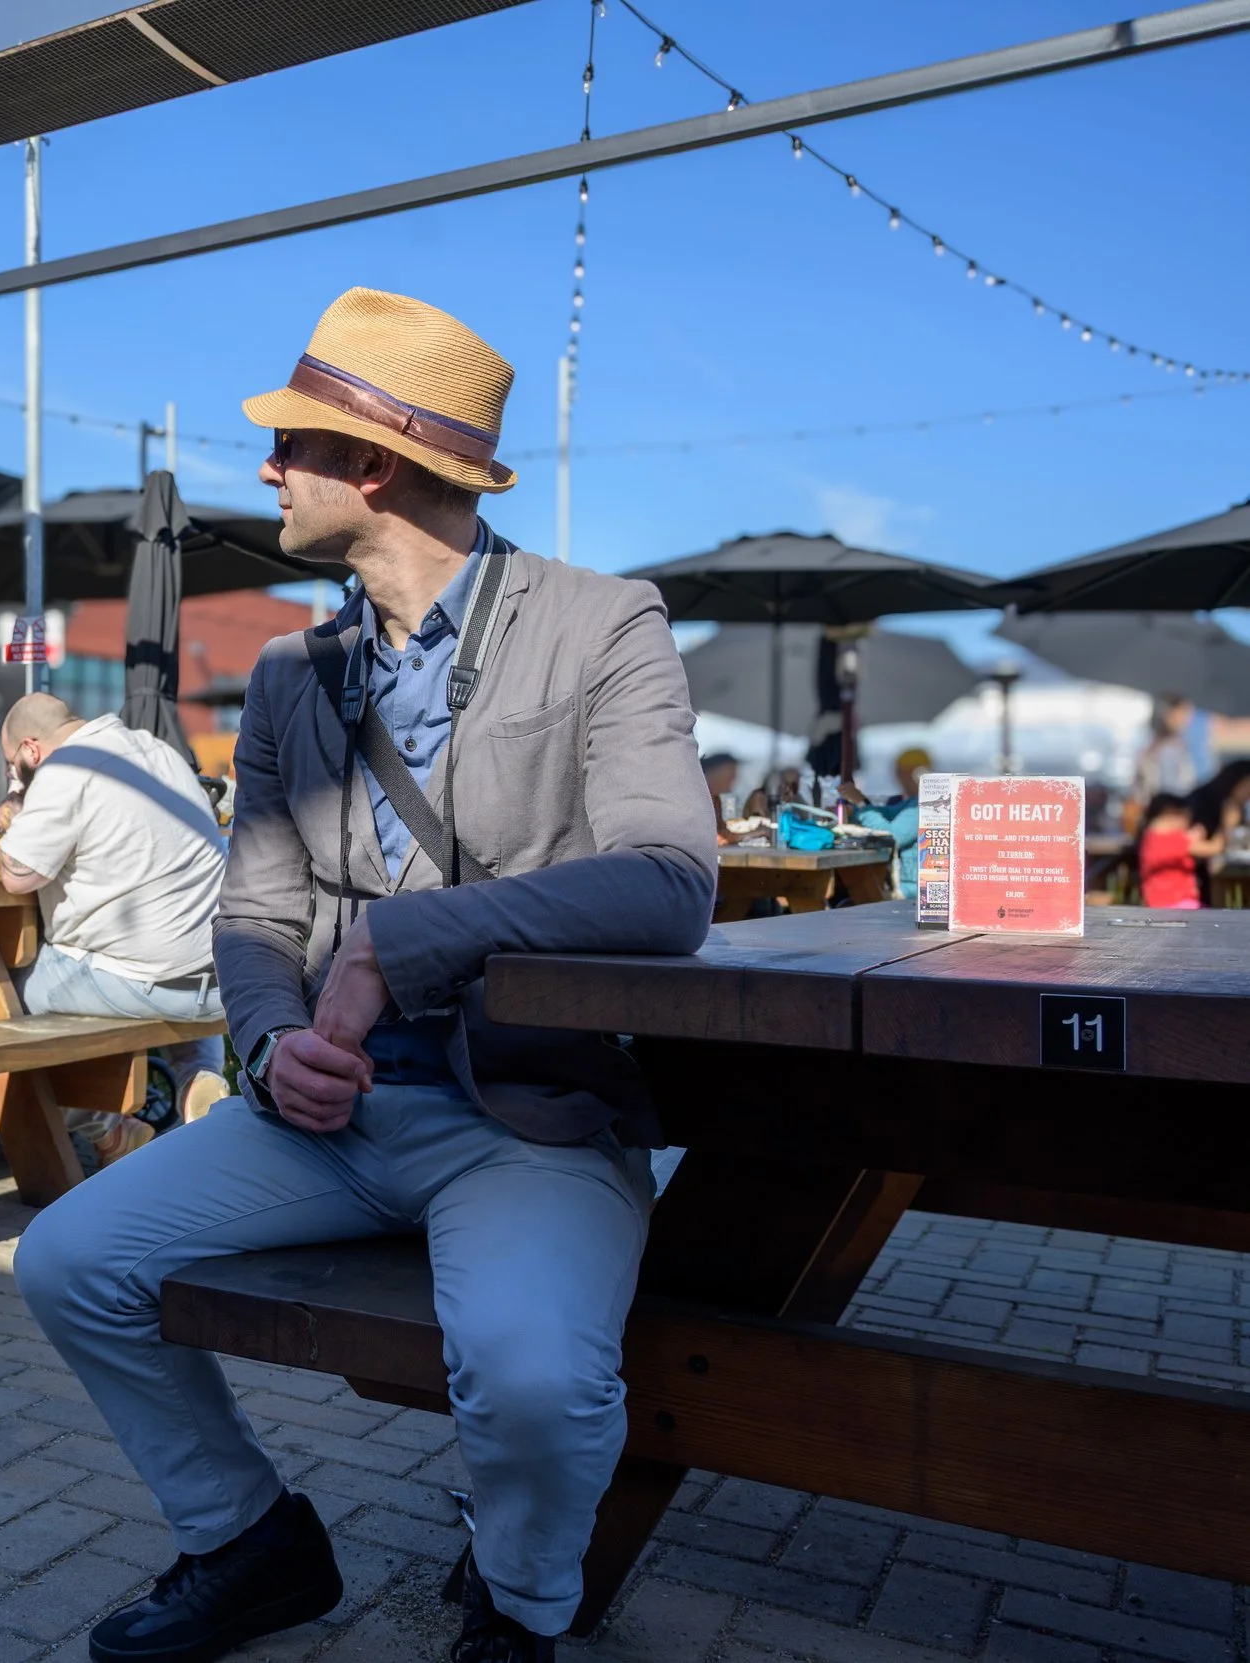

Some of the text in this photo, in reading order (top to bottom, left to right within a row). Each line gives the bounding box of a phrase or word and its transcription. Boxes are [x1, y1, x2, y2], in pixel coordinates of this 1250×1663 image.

[970, 803, 1064, 822] GOT HEAT?
[931, 838, 950, 847] HA
[928, 846, 950, 855] TRI
[998, 850, 1006, 859] TO
[1007, 851, 1022, 859] TURN
[1032, 867, 1045, 875] THE
[962, 873, 988, 881] LOCATED
[1062, 1013, 1102, 1052] 11
